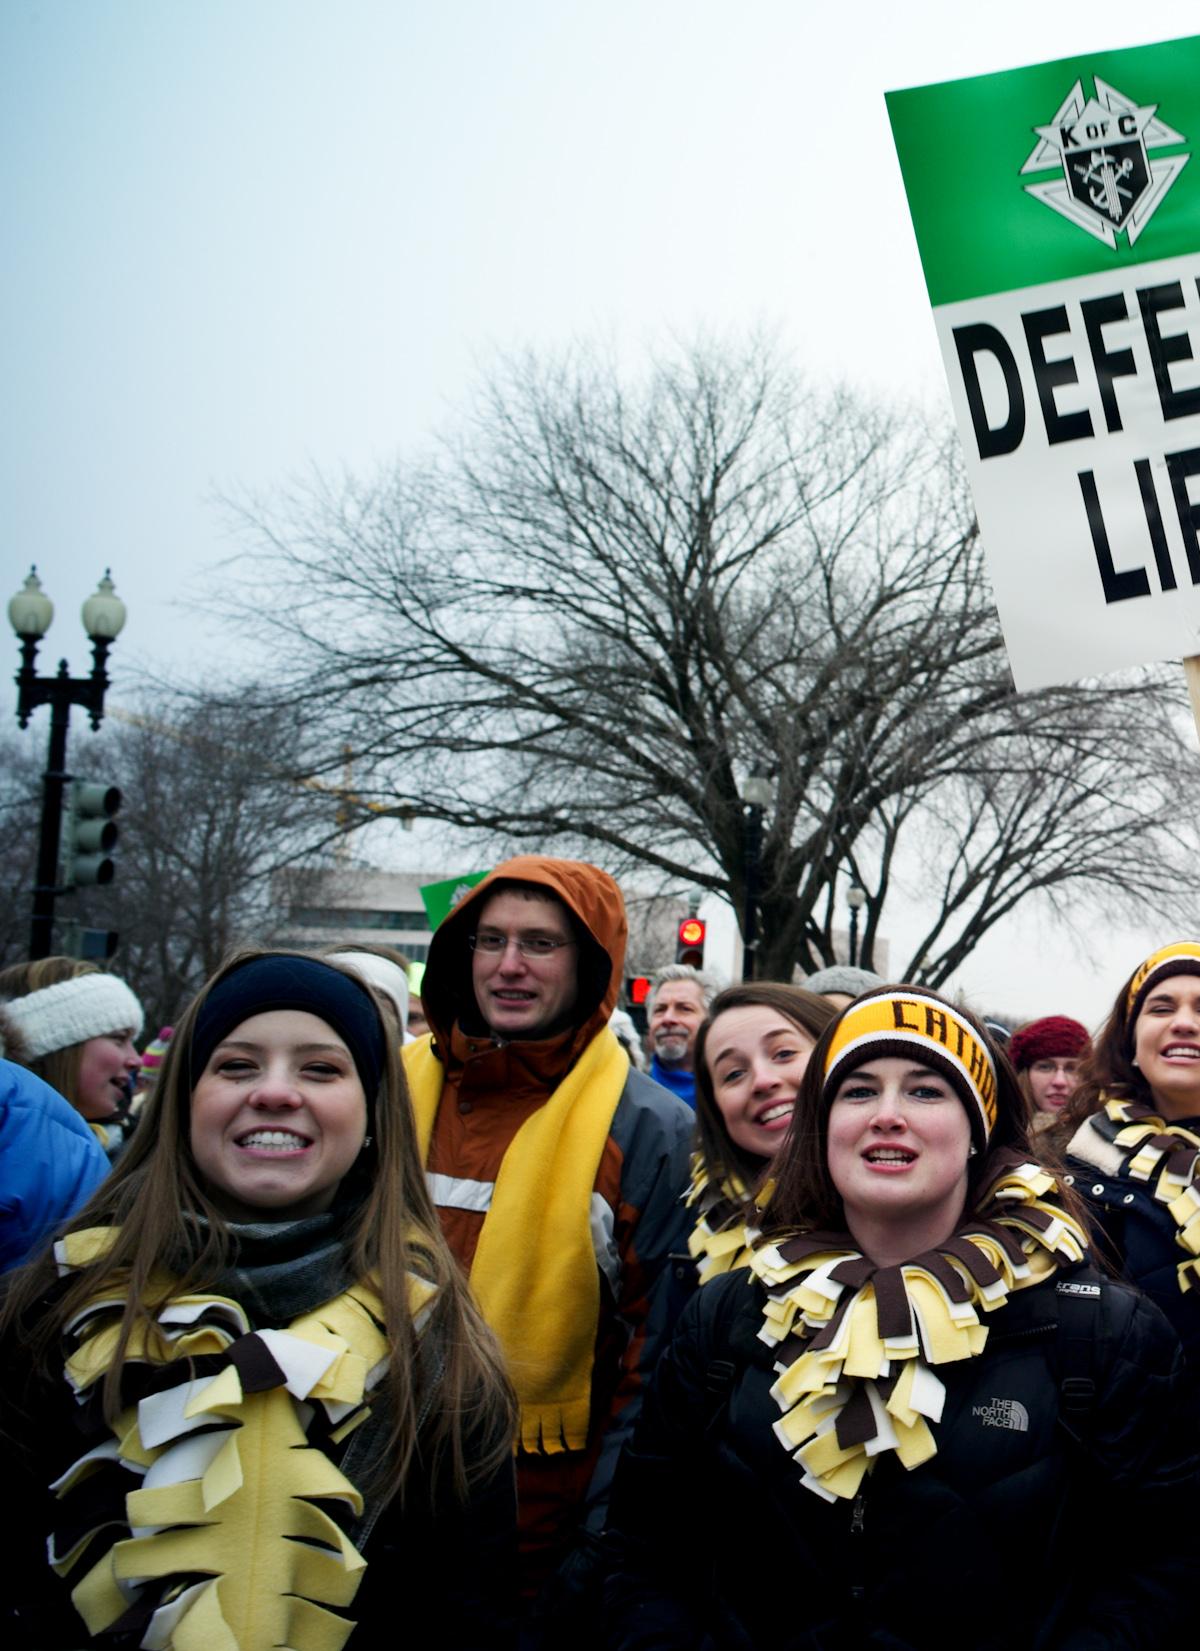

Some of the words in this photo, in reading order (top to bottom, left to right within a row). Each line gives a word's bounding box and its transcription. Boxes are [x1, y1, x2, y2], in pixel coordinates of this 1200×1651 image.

[1060, 123, 1081, 149] K
[1118, 114, 1137, 137] C
[1056, 1281, 1101, 1296] trans
[991, 1397, 1012, 1409] THE
[972, 1406, 1011, 1418] NORTH
[982, 1416, 1011, 1428] FACE
